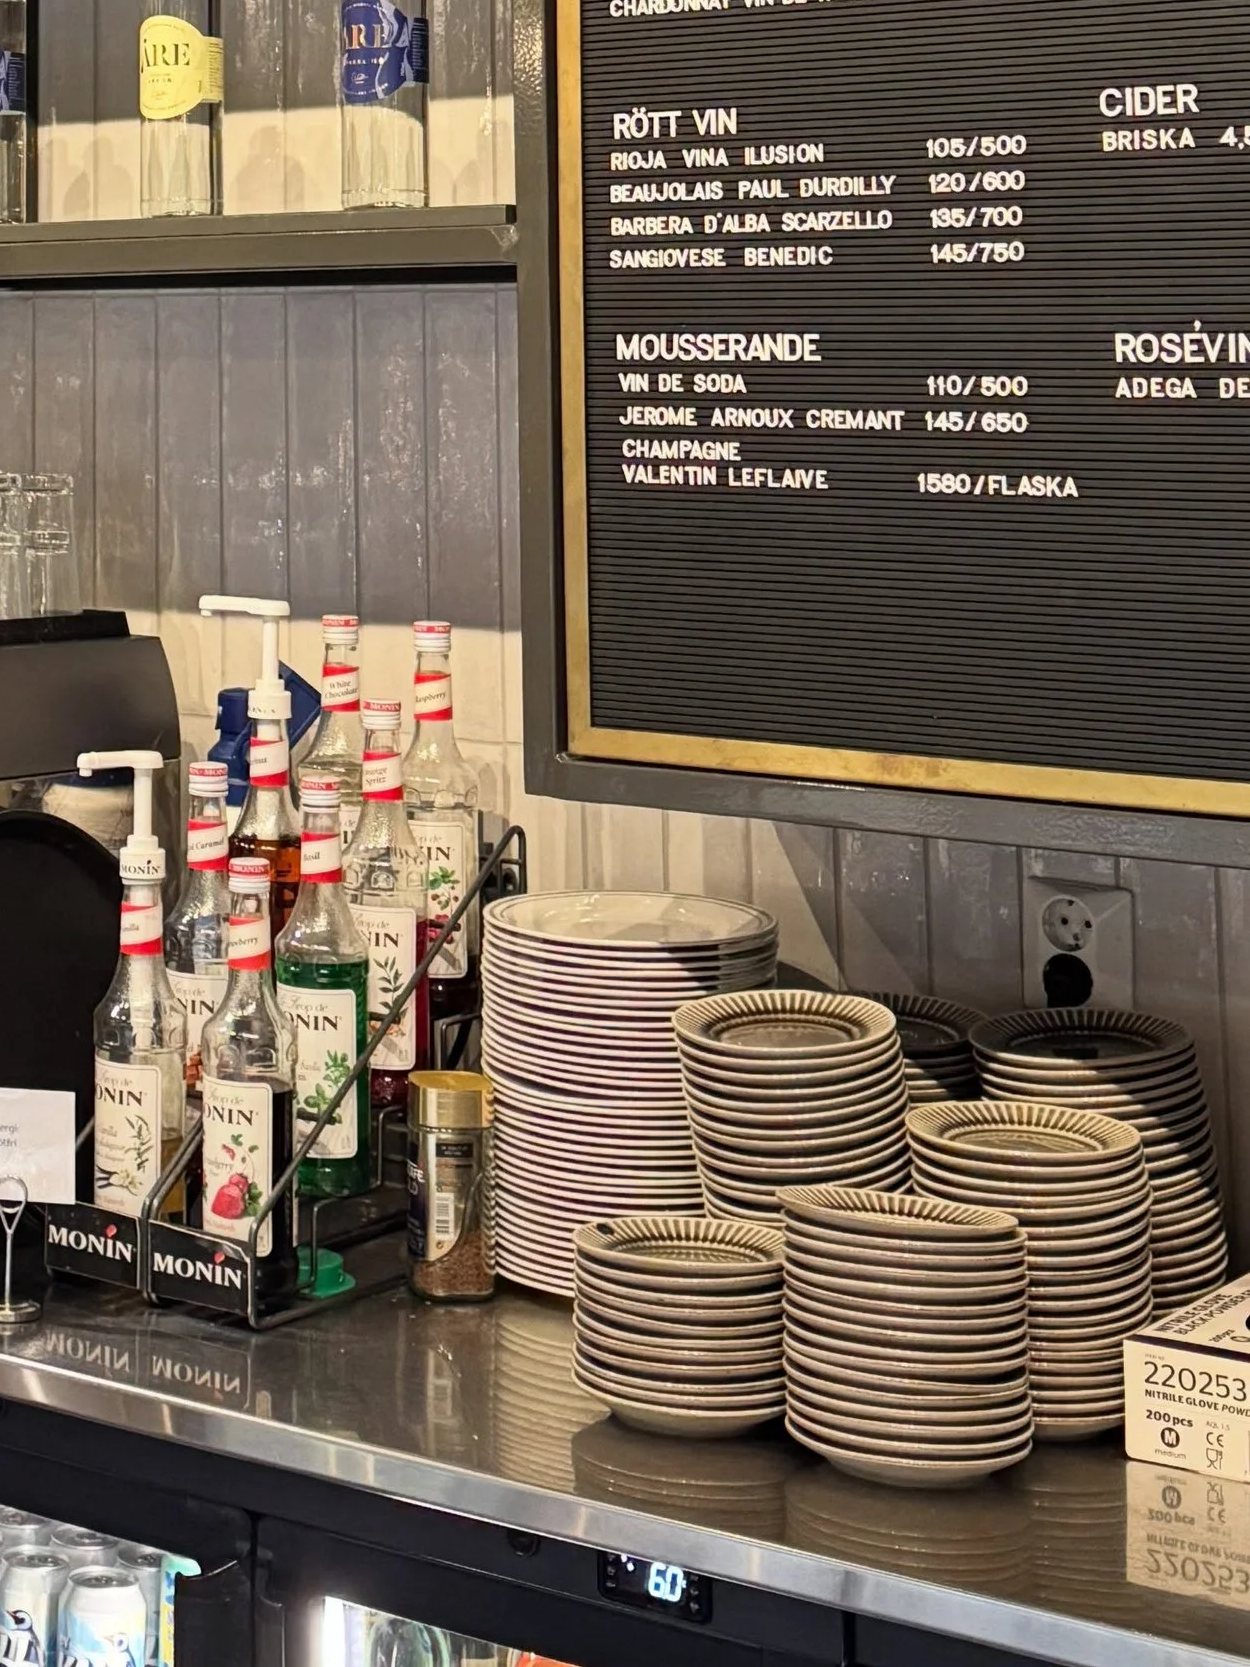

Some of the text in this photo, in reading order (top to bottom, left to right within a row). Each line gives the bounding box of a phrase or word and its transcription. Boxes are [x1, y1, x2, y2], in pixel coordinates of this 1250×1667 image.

[1100, 84, 1200, 117] CIDER
[613, 107, 737, 140] RÖTT VIN
[611, 135, 1027, 170] RIOJA VINA ILUSION 105/500
[1102, 127, 1196, 152] BRISKA
[610, 170, 1026, 203] BEAUJOLAIS PAUL DURDILLY 120/600
[611, 206, 1023, 236] BARBERA D'ALBA SCARZELLO 135/700
[610, 241, 1025, 269] SANGIOVESE BENEDIC 145/750
[616, 333, 821, 361] MOUSSERANDE
[618, 373, 1028, 397] VIN DE SODA 110/500
[1115, 377, 1197, 399] ADEGA
[619, 406, 1029, 433] JEROME ARNOUX CREMANT 145/650
[622, 439, 741, 461] CHAMPAGNE
[622, 464, 716, 485] VALENTIN
[728, 468, 828, 489] LEFLAIVE
[48, 1224, 133, 1263] MONIN
[153, 1251, 242, 1290] MONIN
[1144, 1361, 1247, 1402] 220253
[1145, 1389, 1219, 1411] NITRILE GLOVE
[1146, 1409, 1171, 1423] 200
[1172, 1416, 1193, 1427] pcs
